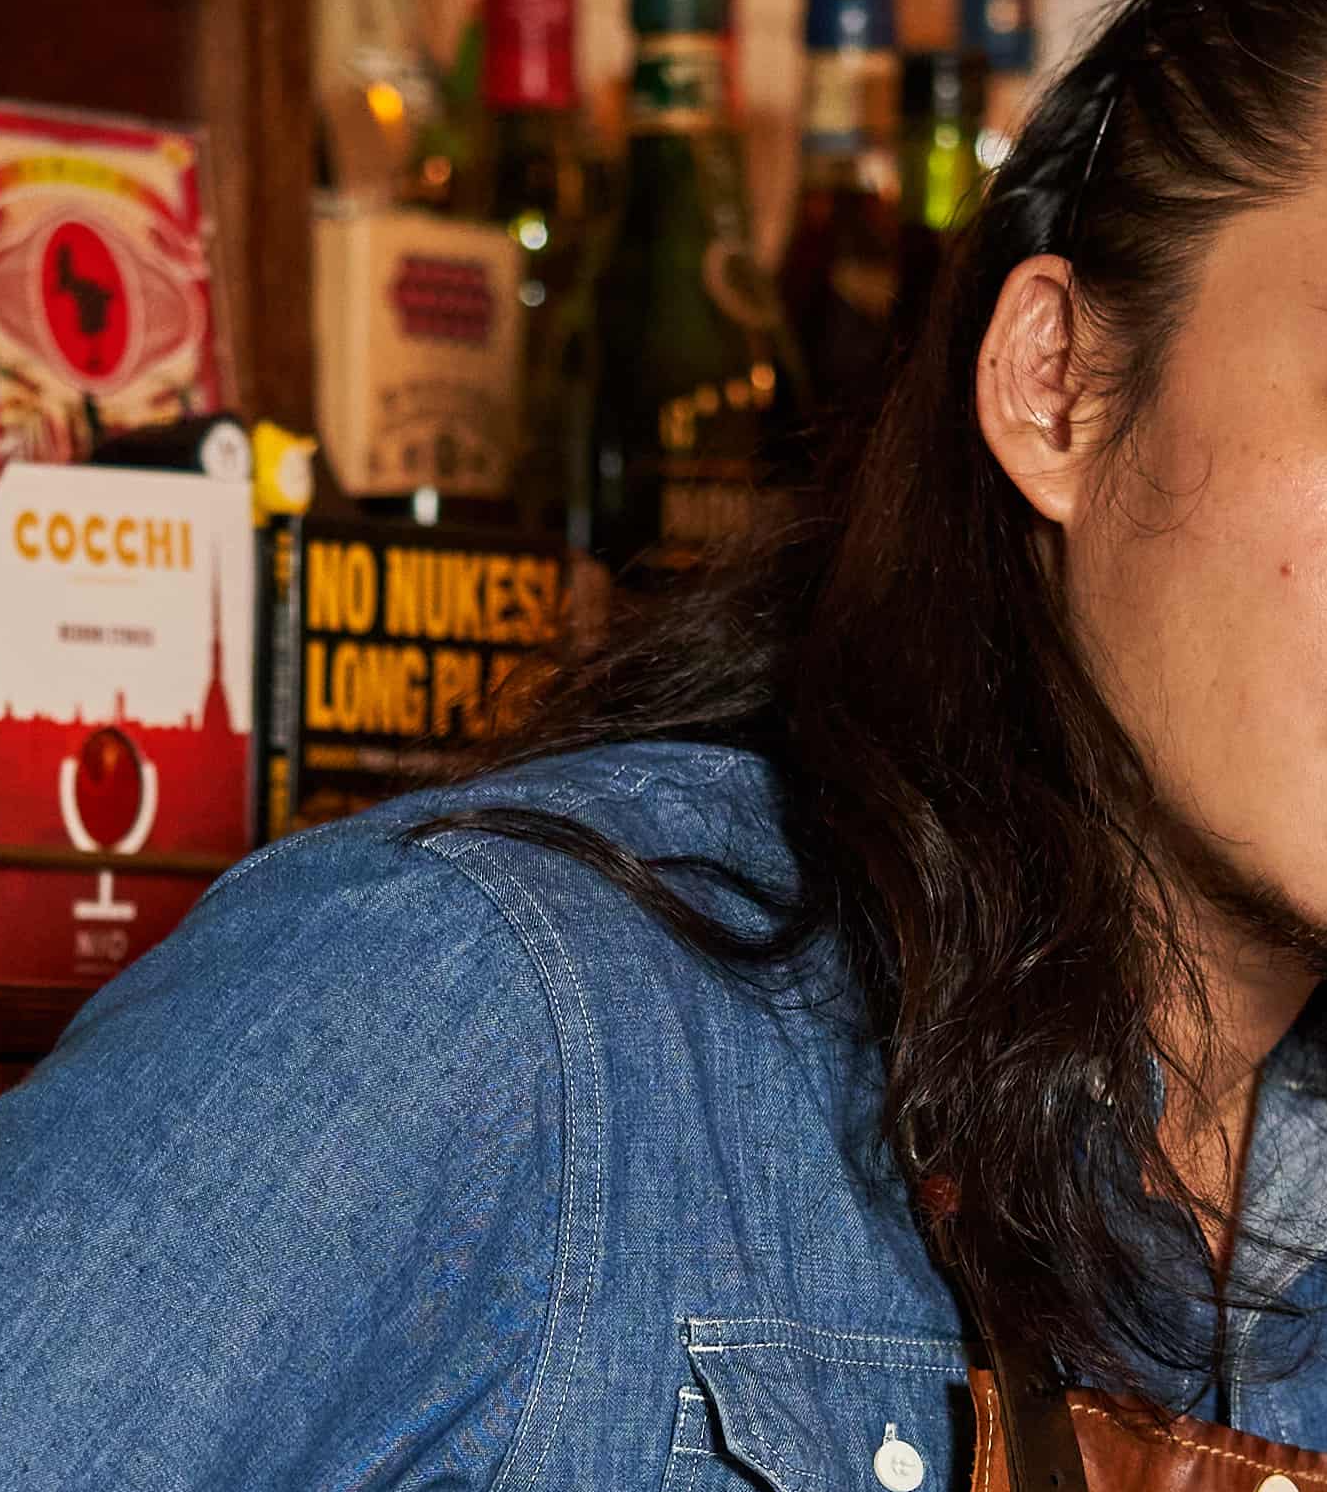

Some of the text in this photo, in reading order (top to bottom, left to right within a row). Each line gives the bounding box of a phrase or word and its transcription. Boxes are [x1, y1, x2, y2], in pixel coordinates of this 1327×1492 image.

[13, 510, 193, 572] COCCHI
[305, 540, 374, 635] NO
[304, 639, 427, 736] LONG
